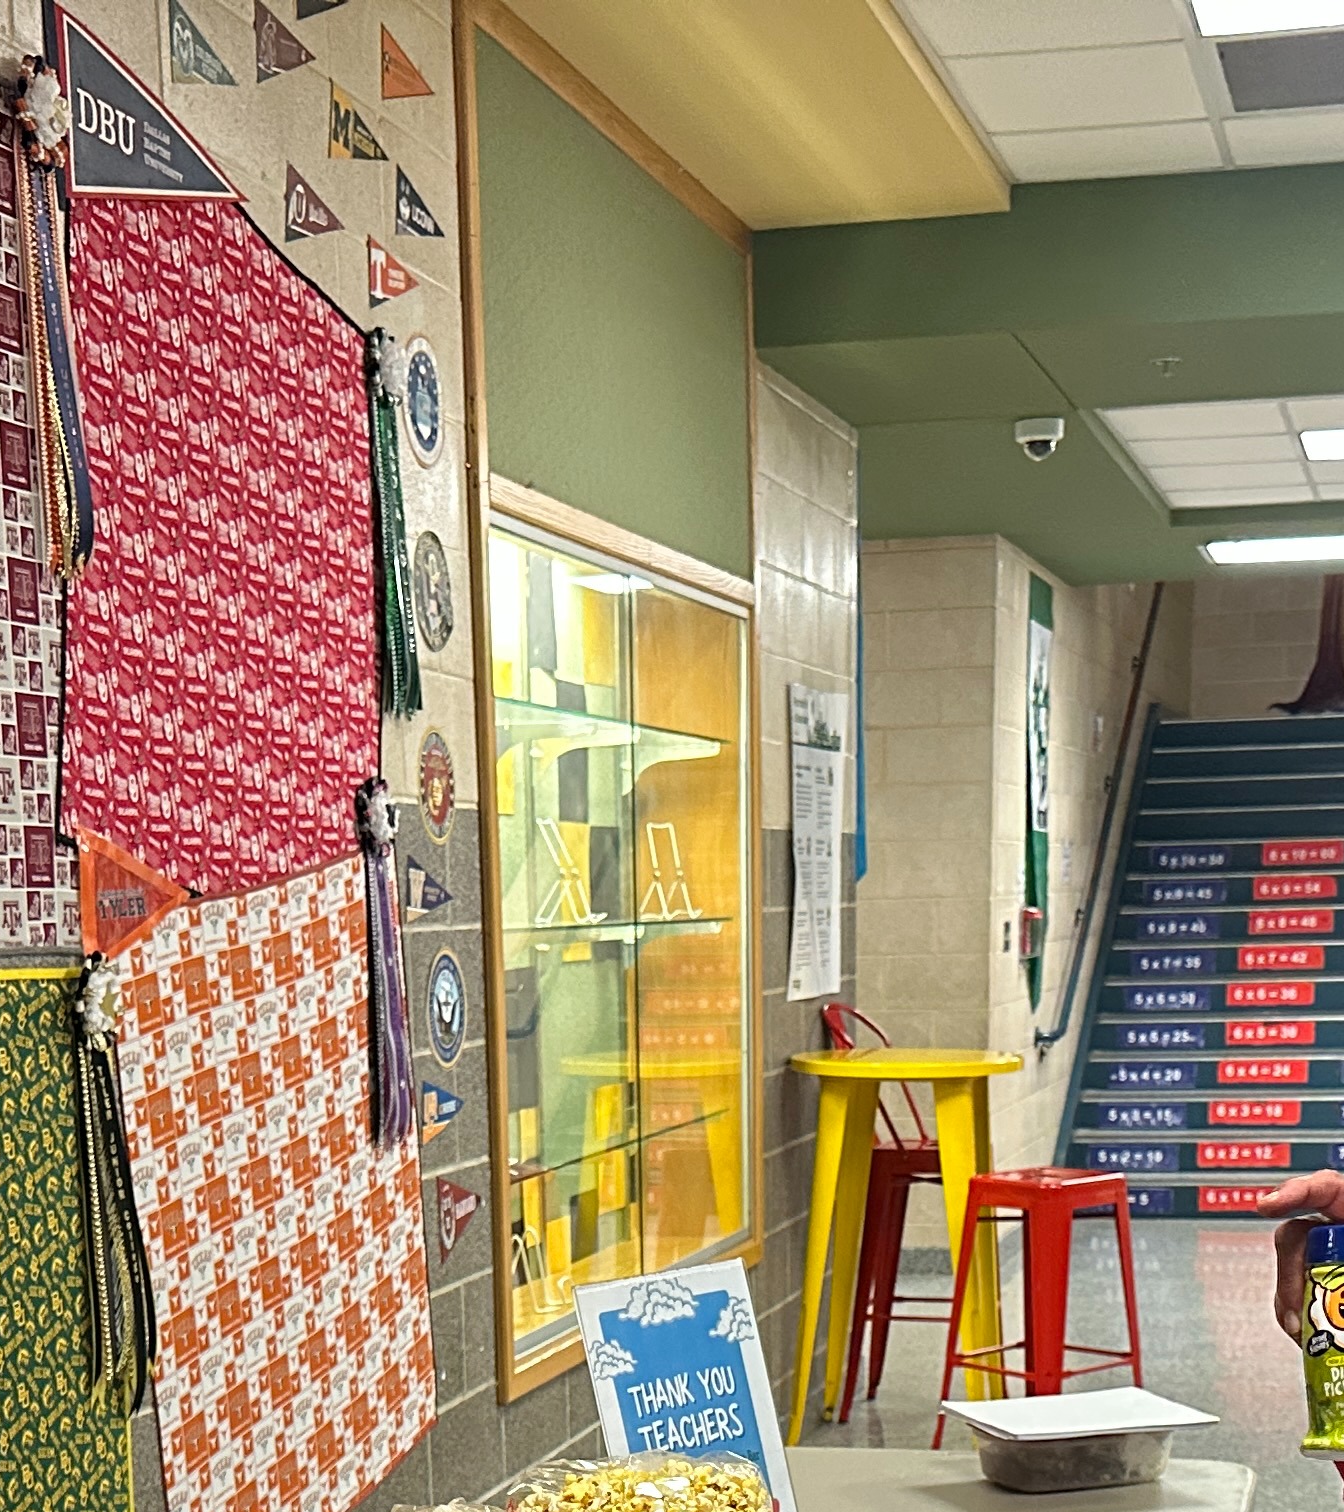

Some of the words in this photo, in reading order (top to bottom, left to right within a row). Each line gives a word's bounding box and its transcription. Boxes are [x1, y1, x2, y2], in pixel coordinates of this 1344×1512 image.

[77, 87, 136, 155] DBU
[98, 897, 146, 918] TYLER
[627, 1371, 695, 1418] THANK
[696, 1365, 736, 1401] YOU
[637, 1402, 745, 1453] TEACHERS
